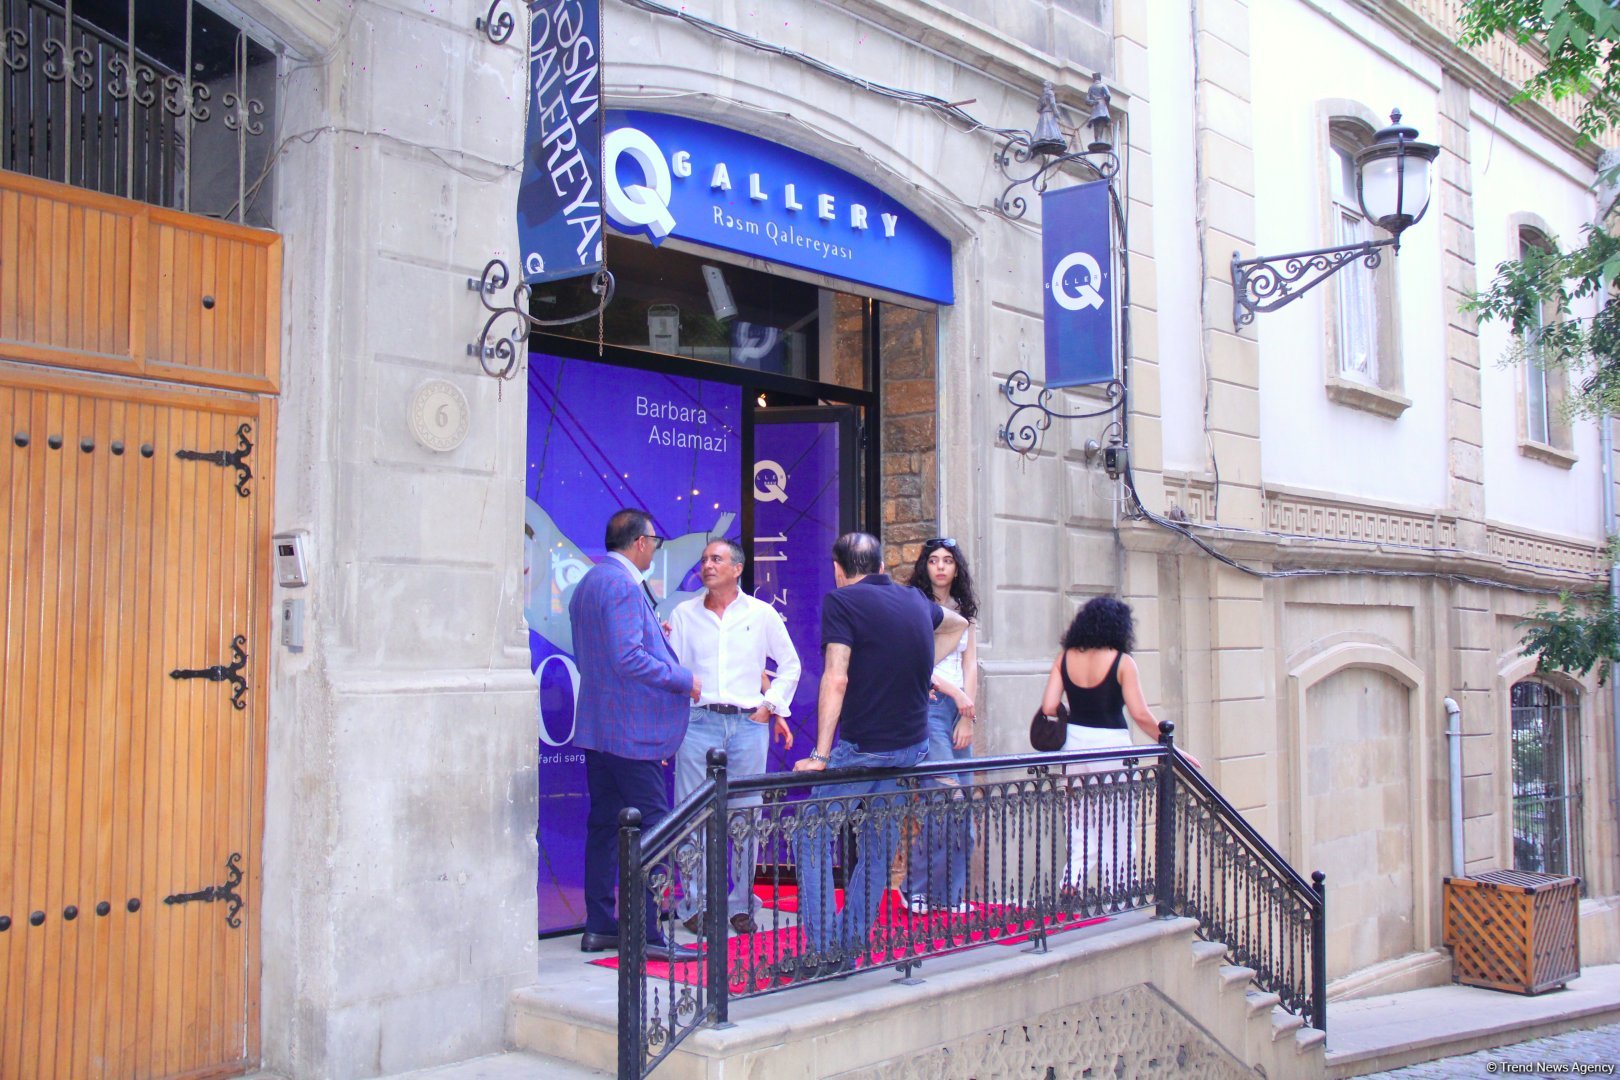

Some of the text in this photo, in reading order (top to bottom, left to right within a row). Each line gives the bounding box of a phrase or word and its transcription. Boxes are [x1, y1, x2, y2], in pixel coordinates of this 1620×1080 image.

[553, 0, 599, 126] ƏSM
[603, 127, 899, 238] Q GALLERY
[713, 205, 853, 260] Rəsm Qalereyası
[526, 252, 545, 275] Q
[1051, 252, 1105, 311] Q
[435, 404, 449, 428] 6
[636, 396, 707, 424] Barbara
[648, 425, 727, 453] Aslamazi
[753, 459, 789, 504] Q
[564, 754, 586, 764] sərg
